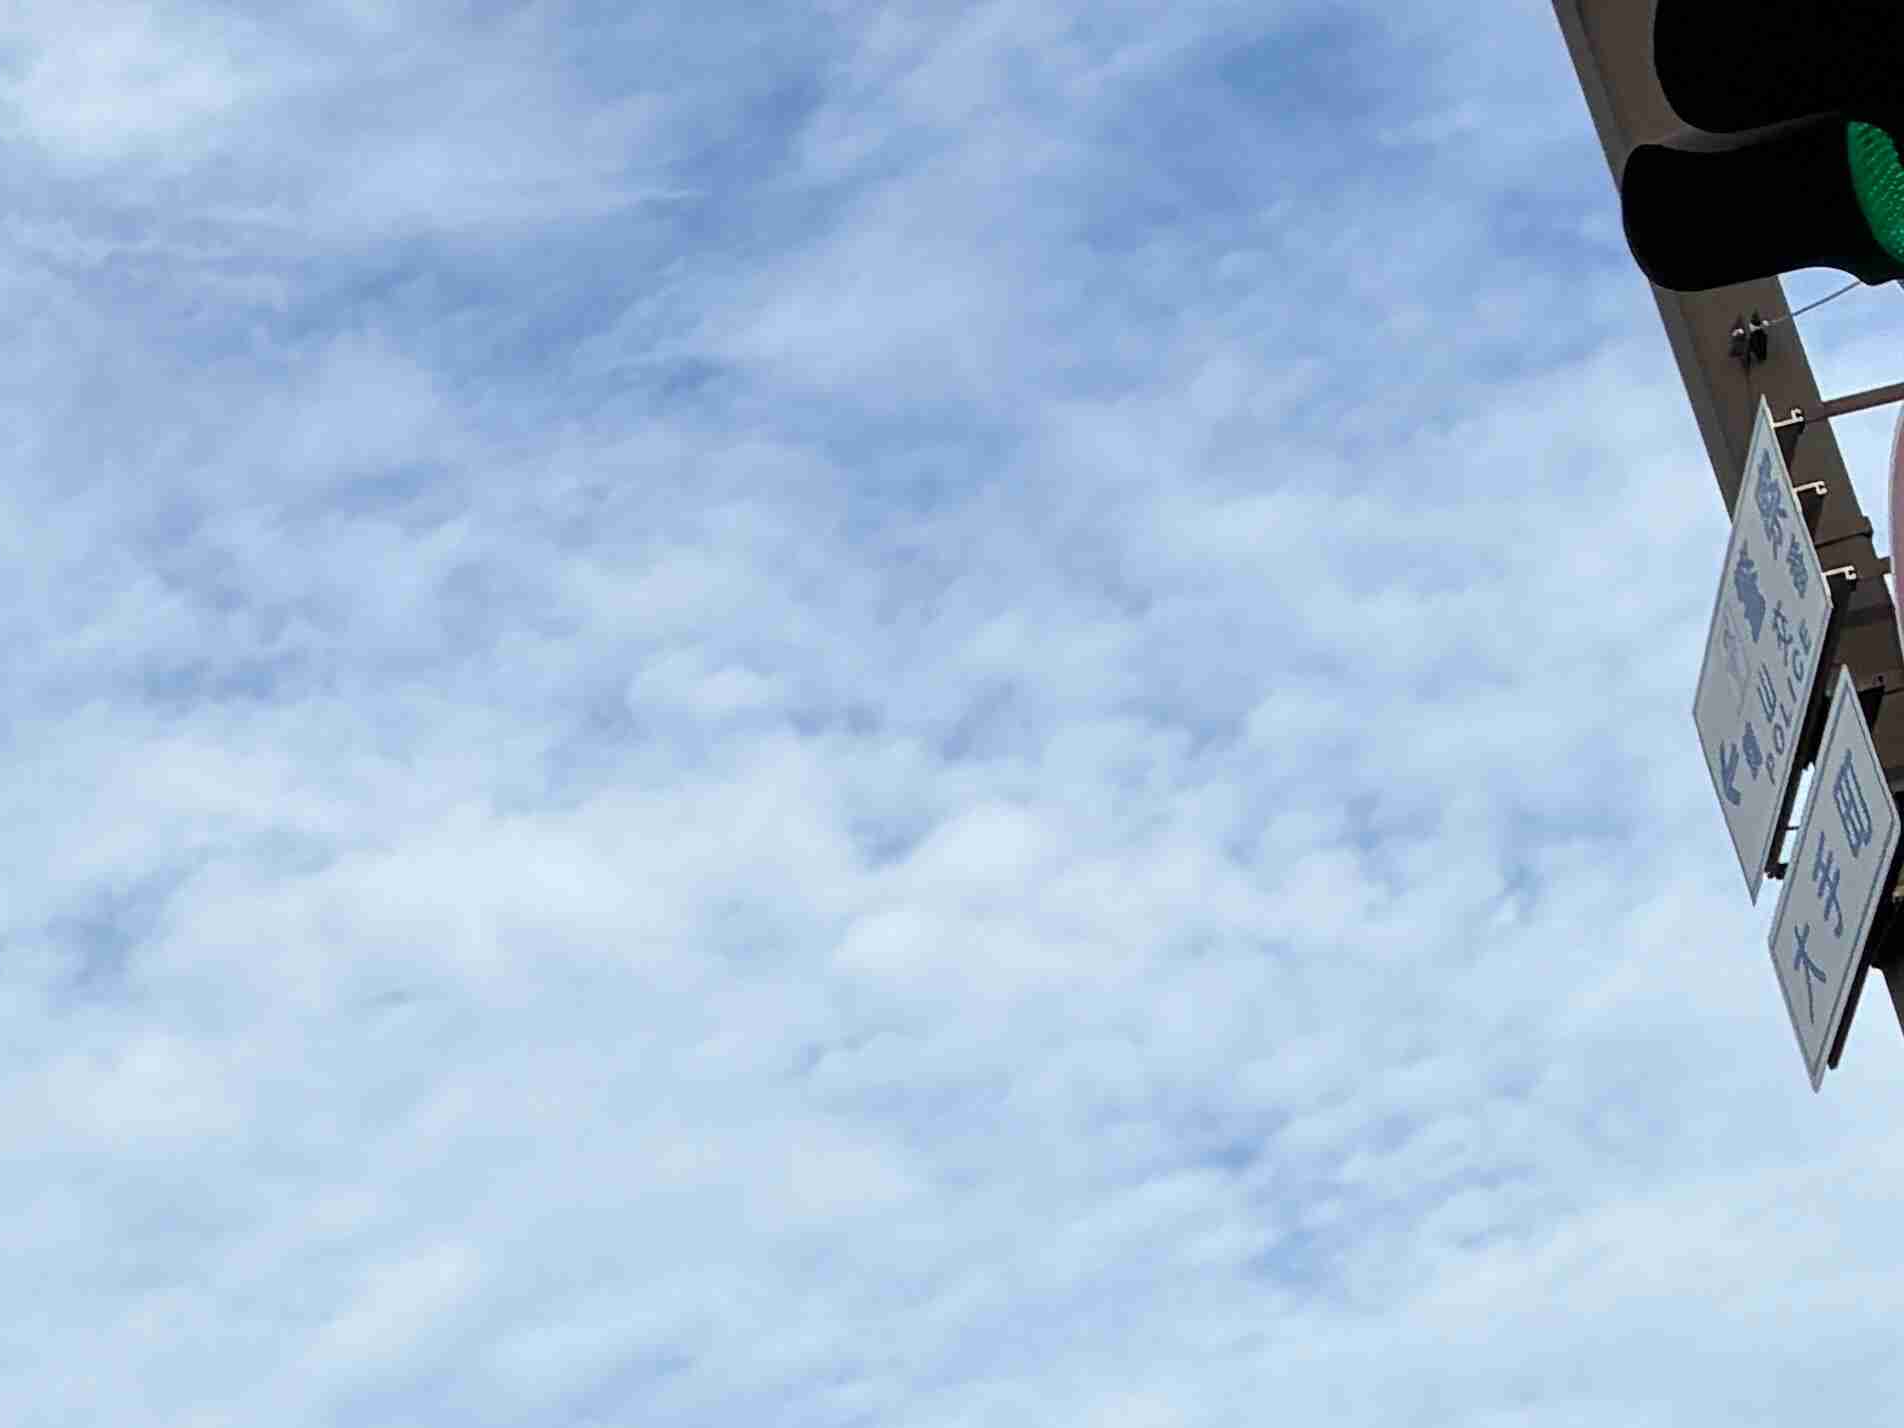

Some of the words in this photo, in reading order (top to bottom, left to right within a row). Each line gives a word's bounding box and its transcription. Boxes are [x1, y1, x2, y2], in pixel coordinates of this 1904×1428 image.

[1765, 618, 1814, 784] POLICE
[1794, 748, 1873, 1025] 大手町
